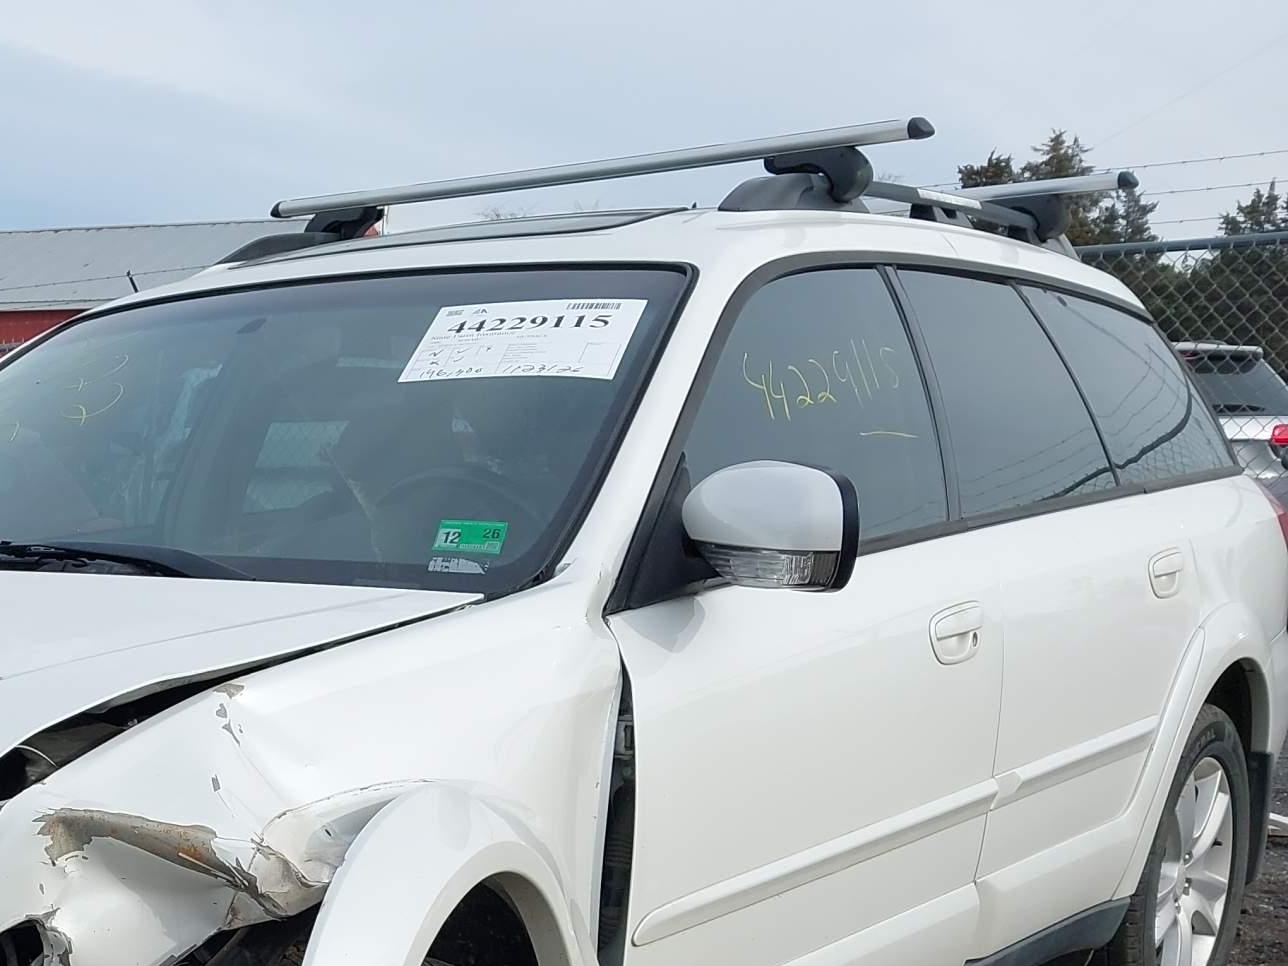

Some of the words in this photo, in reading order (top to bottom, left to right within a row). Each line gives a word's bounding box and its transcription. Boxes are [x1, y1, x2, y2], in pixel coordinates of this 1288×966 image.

[447, 314, 614, 334] 44229115
[442, 531, 462, 544] 12
[482, 528, 502, 539] 26
